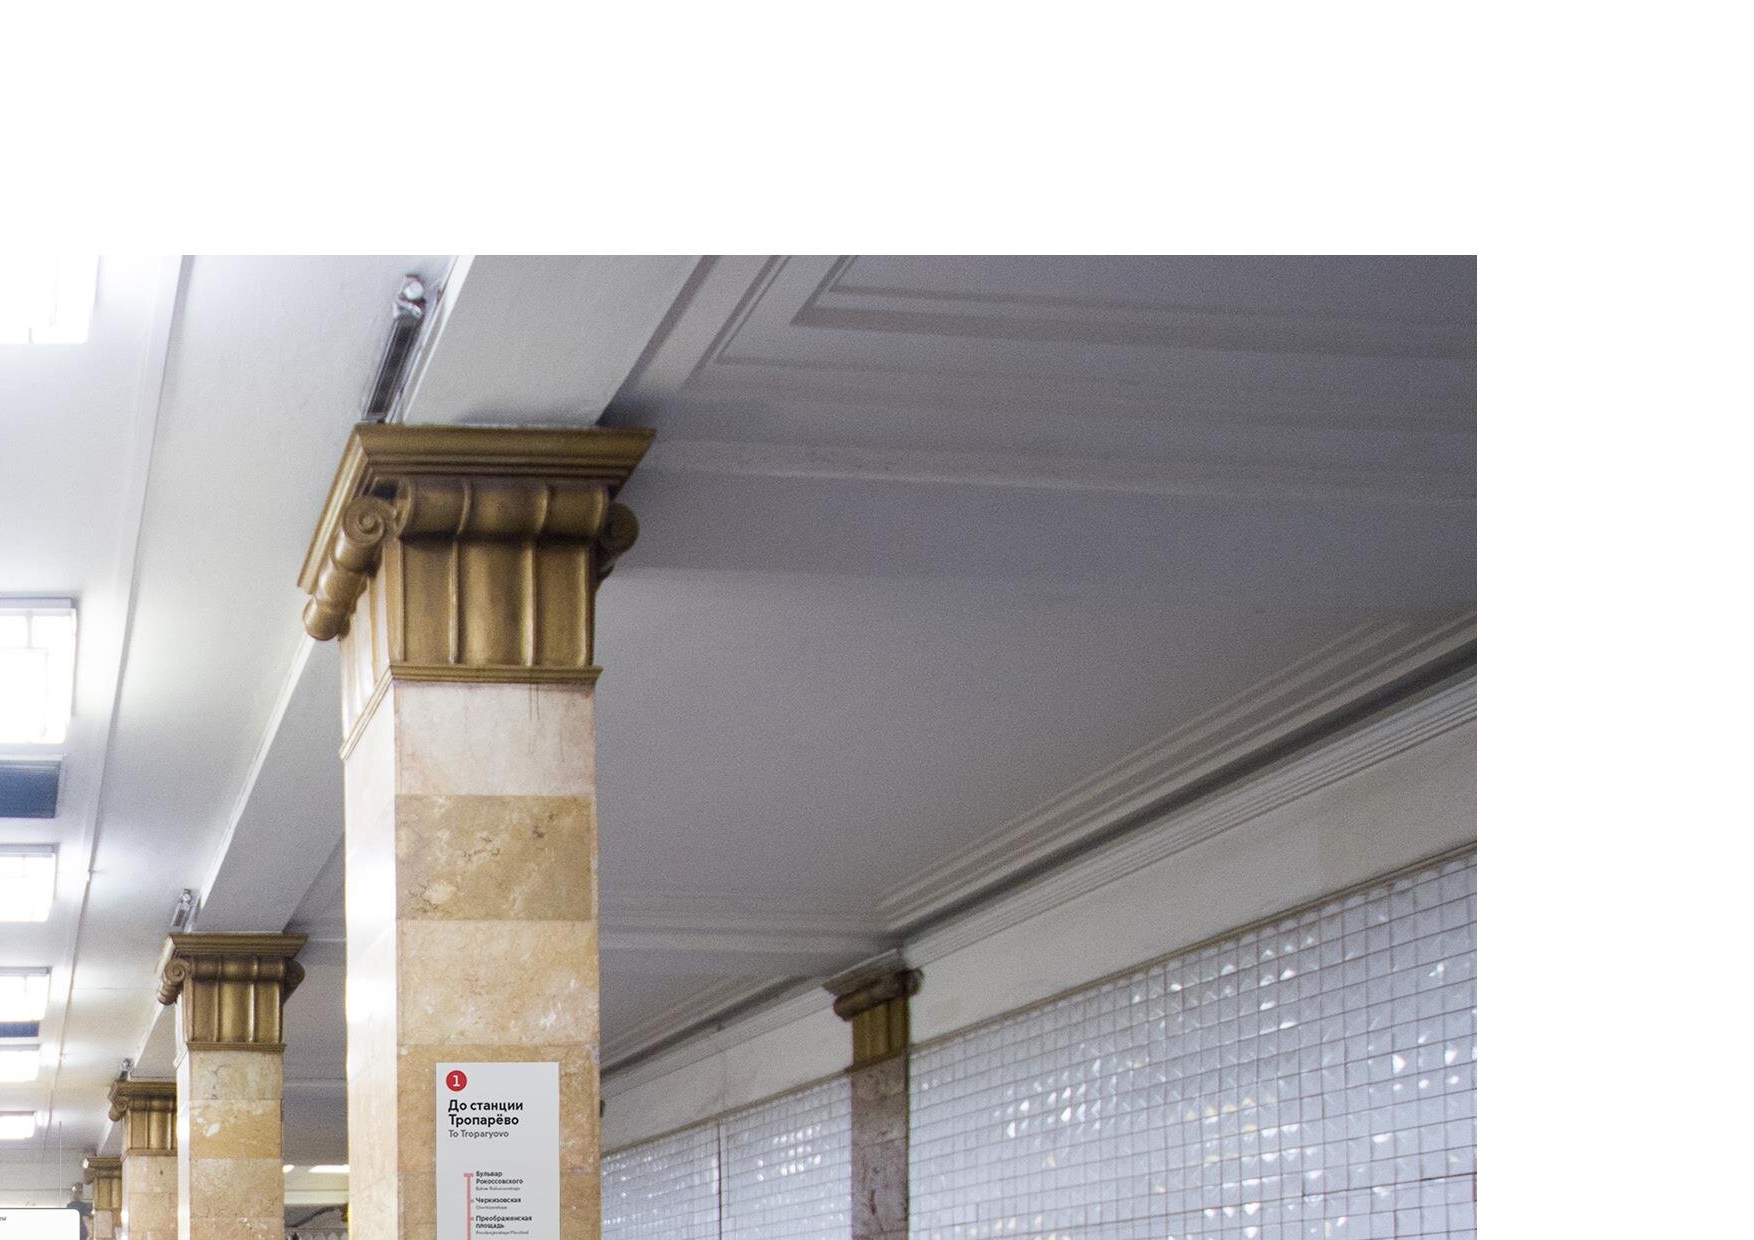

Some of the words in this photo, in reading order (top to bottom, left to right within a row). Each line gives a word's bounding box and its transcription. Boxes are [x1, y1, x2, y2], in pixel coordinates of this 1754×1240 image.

[448, 1099, 467, 1113] До
[470, 1102, 524, 1112] станции
[448, 1113, 519, 1128] Тропарёво
[460, 1130, 509, 1139] Troparyovo
